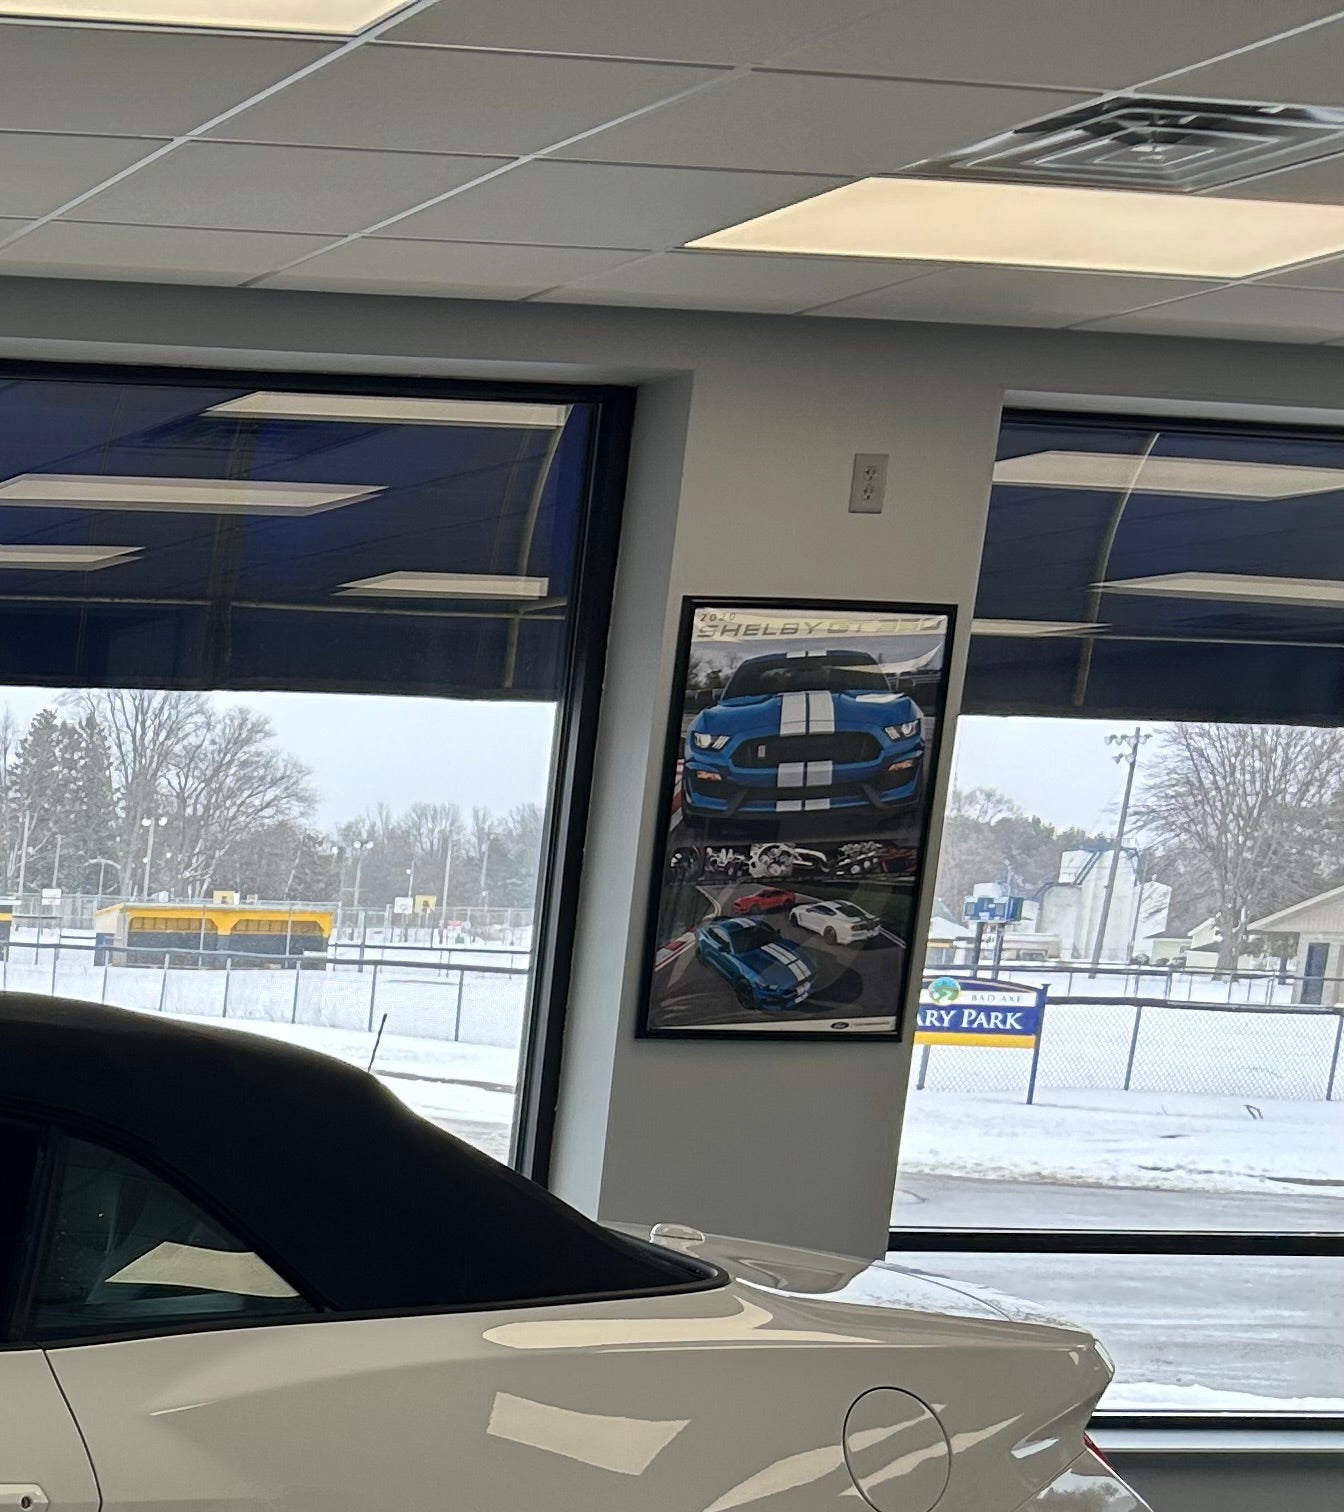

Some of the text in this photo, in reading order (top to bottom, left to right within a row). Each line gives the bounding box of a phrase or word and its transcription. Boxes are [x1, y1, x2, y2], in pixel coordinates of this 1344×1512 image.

[699, 612, 736, 623] 2020
[696, 621, 824, 639] SHELBY
[971, 994, 996, 1002] BAD
[960, 1008, 1024, 1030] PARK
